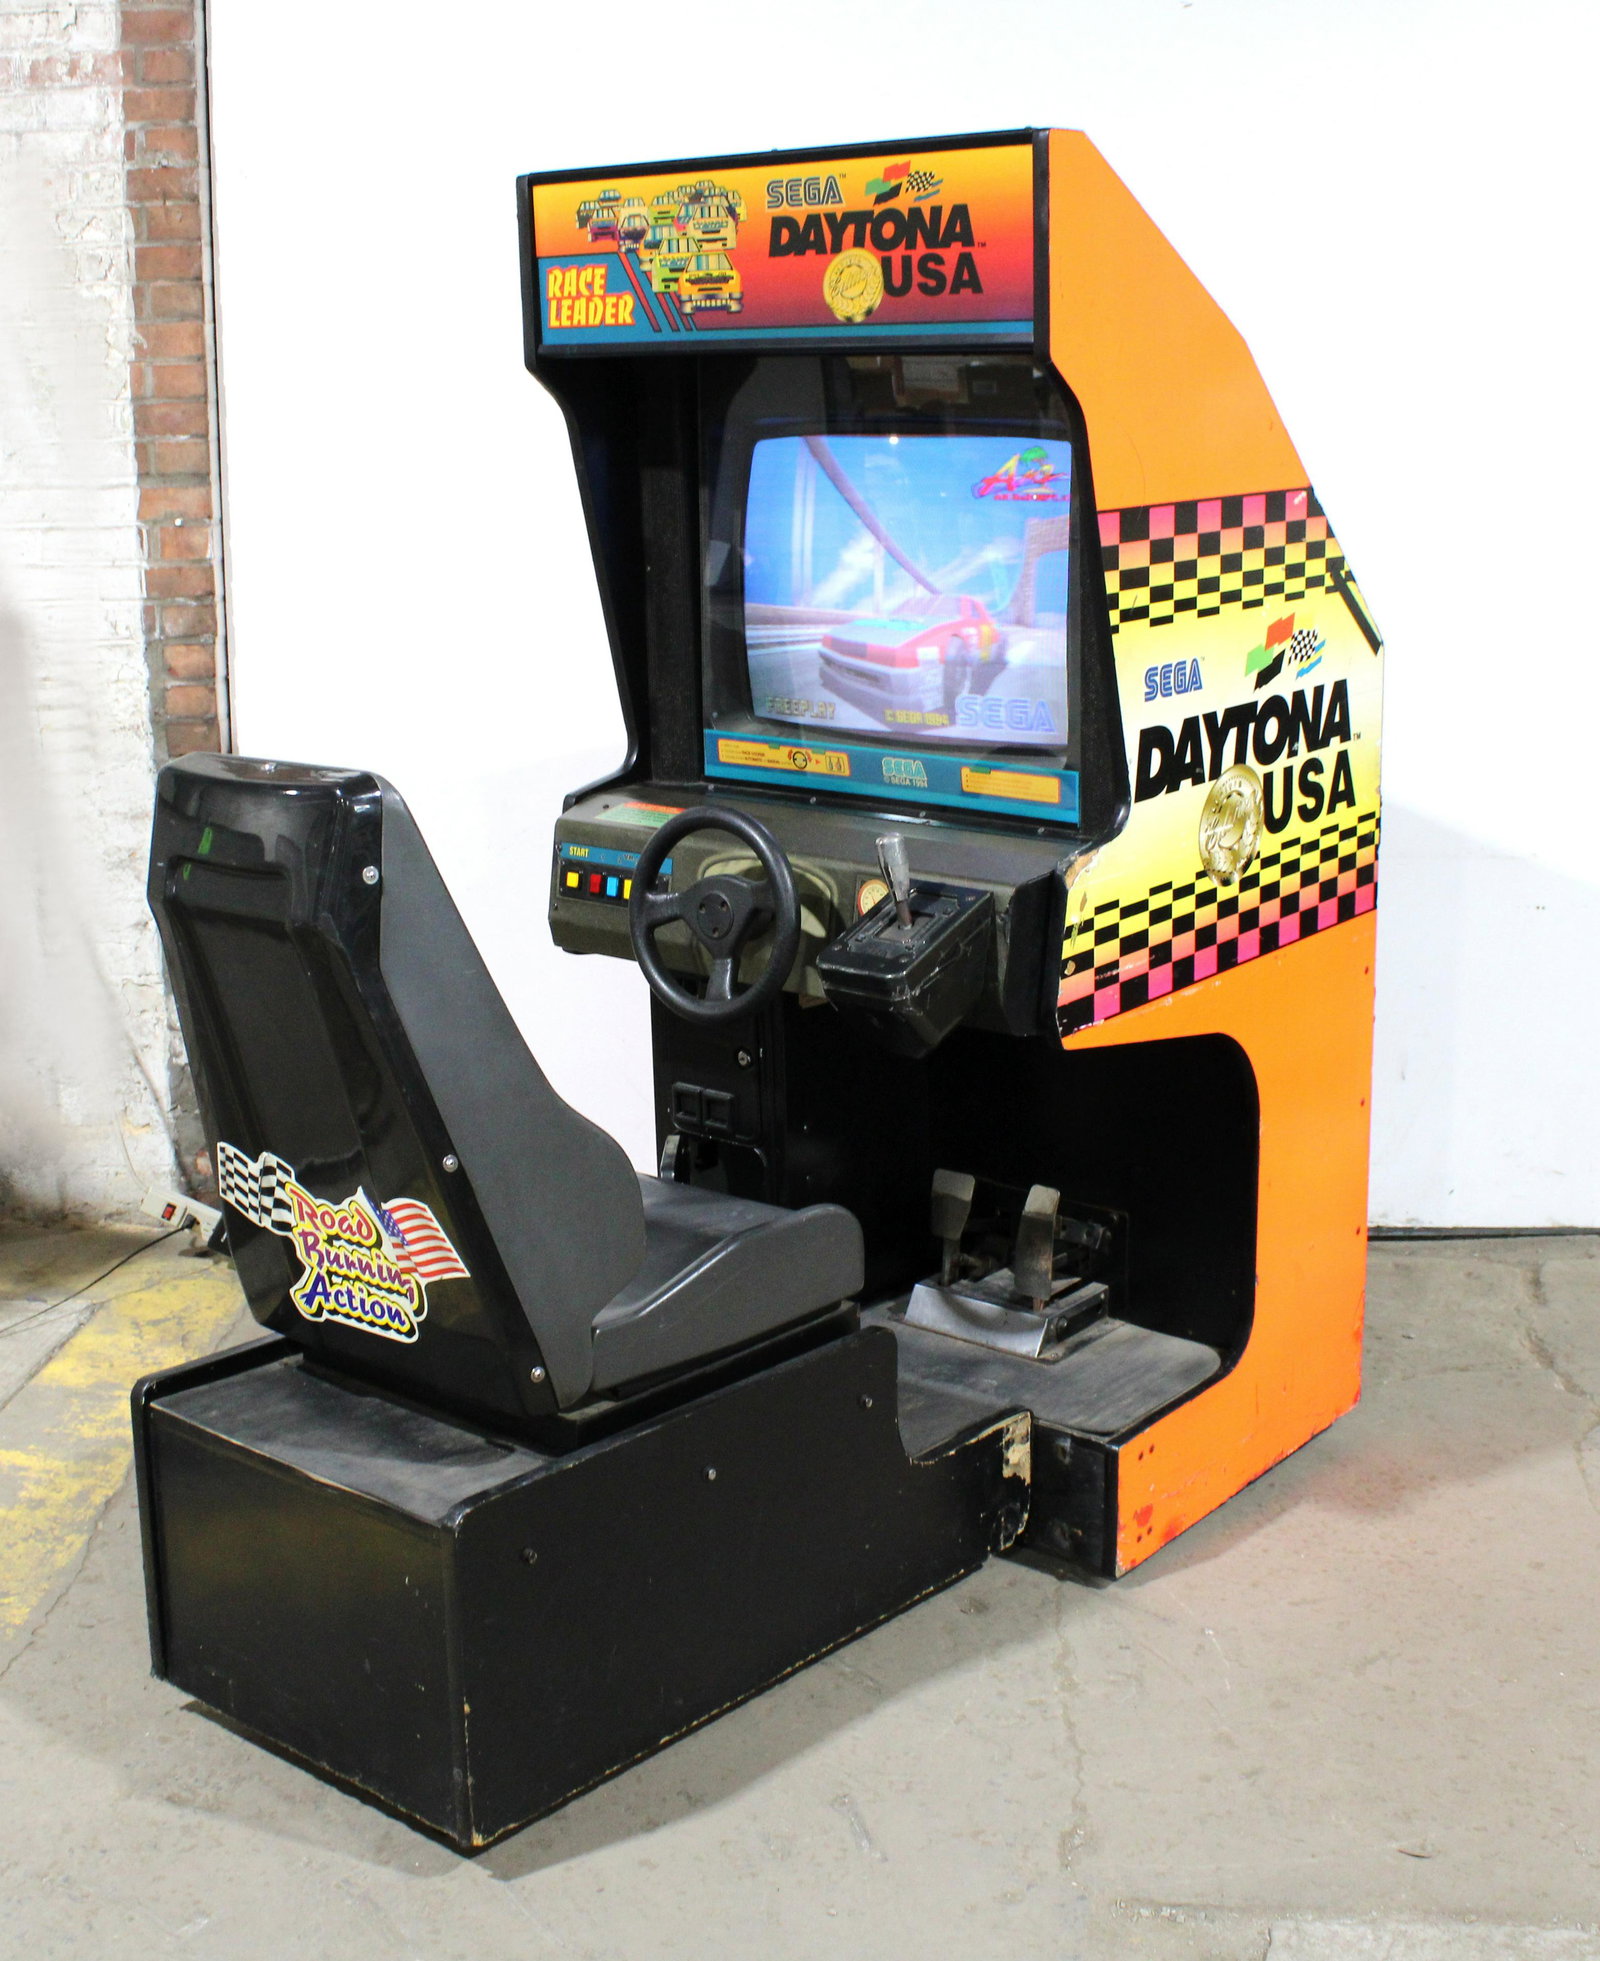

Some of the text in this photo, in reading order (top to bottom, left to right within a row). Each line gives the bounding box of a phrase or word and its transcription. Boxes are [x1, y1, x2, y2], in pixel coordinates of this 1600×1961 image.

[766, 174, 844, 210] SEGA
[769, 203, 975, 257] DAYTONA
[547, 264, 606, 299] RACE
[881, 251, 984, 297] USA
[548, 294, 635, 328] LEADER
[1144, 657, 1203, 703] SEGA
[766, 697, 837, 720] FREEPLAY
[956, 695, 1057, 734] SEGA
[1135, 679, 1351, 803] DAYTONA
[882, 756, 928, 779] SEGA
[1262, 749, 1356, 834] USA
[569, 846, 589, 858] START
[288, 1186, 374, 1241] Road
[299, 1272, 406, 1327] Action
